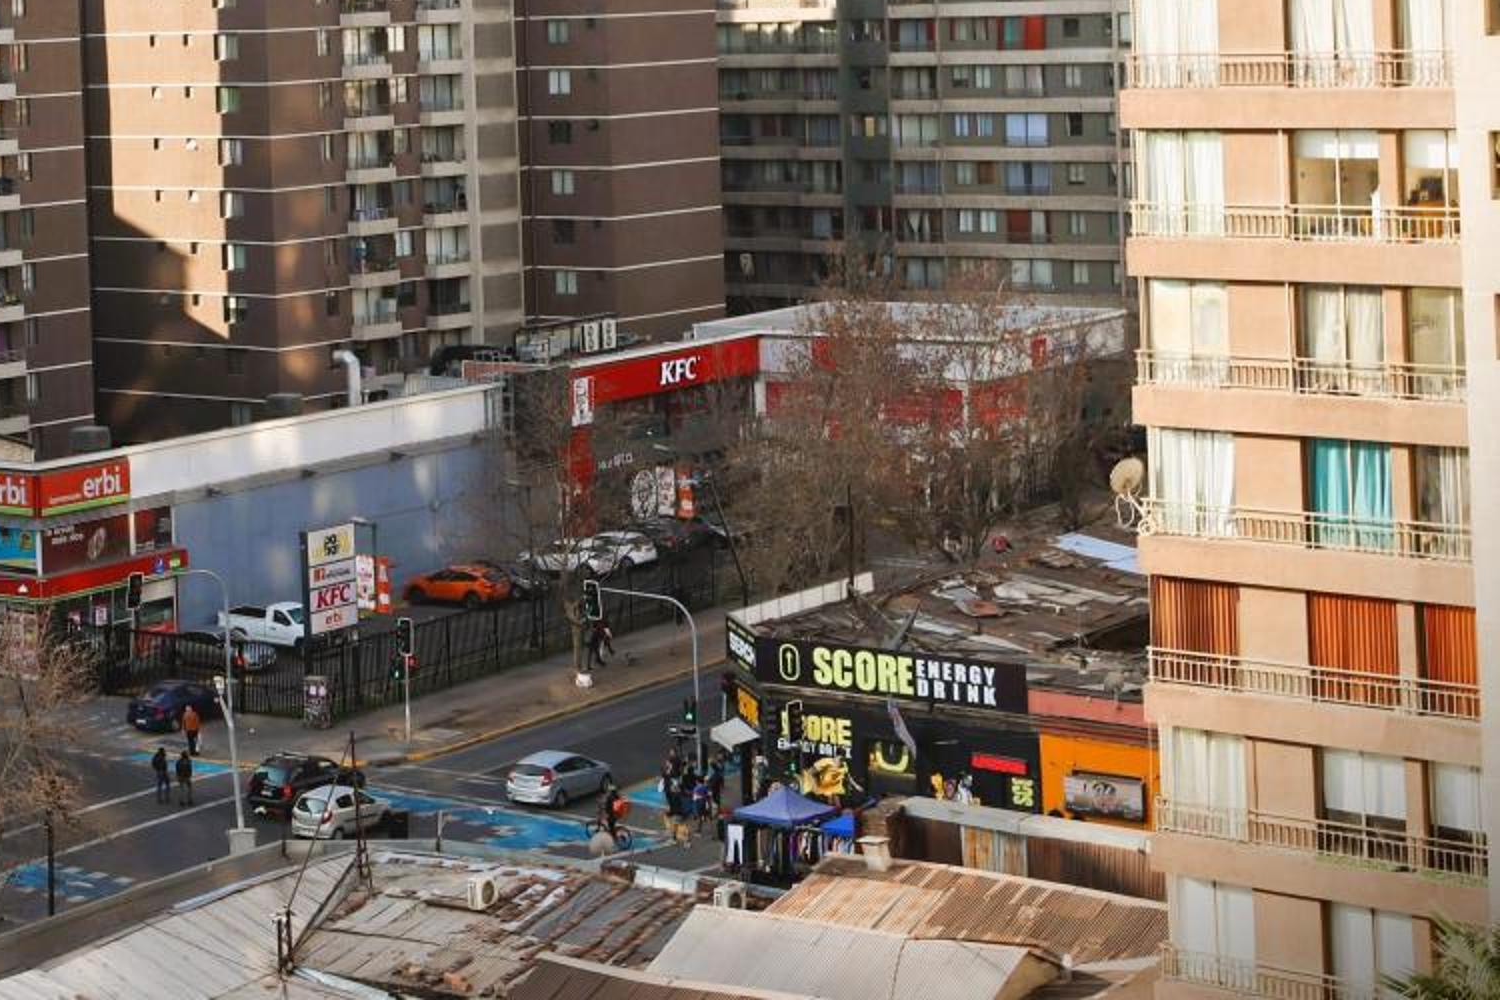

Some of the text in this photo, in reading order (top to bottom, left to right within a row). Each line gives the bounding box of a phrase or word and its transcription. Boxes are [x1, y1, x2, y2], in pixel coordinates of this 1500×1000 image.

[660, 355, 698, 386] KFC
[83, 464, 122, 498] erbi
[316, 583, 351, 609] KFC
[812, 646, 915, 696] SCORE
[915, 658, 996, 686] ENERGY
[916, 678, 997, 707] DRINK
